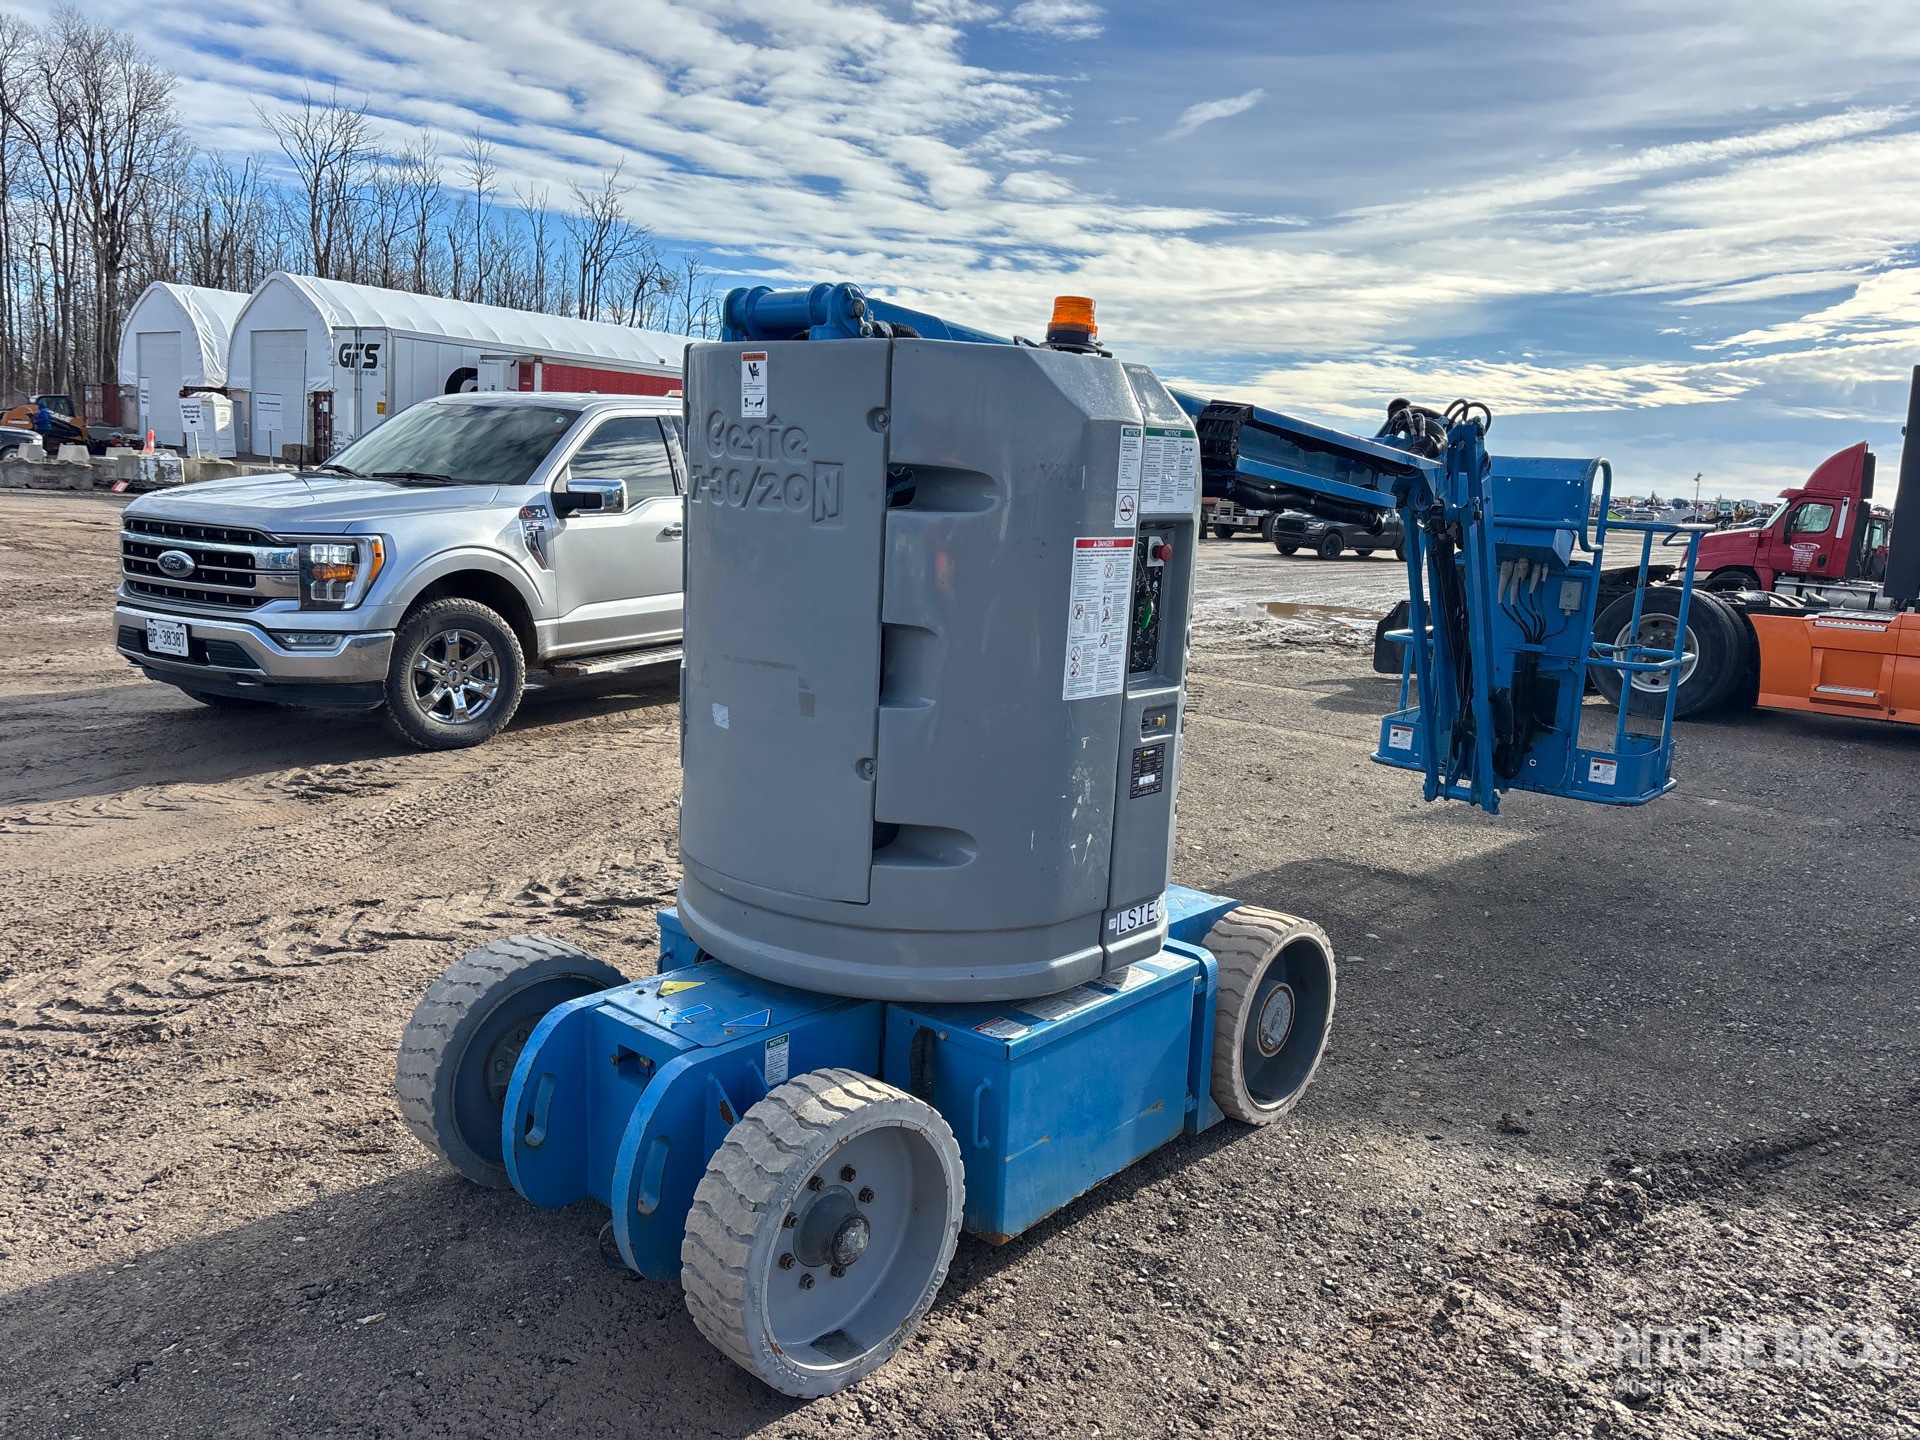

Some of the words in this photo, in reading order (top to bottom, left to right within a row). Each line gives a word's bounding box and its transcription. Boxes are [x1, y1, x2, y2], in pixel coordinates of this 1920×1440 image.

[338, 343, 381, 369] GFS
[1125, 428, 1140, 437] NOTICE
[1164, 429, 1182, 437] NOTICE
[163, 556, 182, 570] Ford
[147, 627, 158, 643] BP
[161, 629, 185, 648] 38387
[769, 1036, 786, 1048] NOTICE
